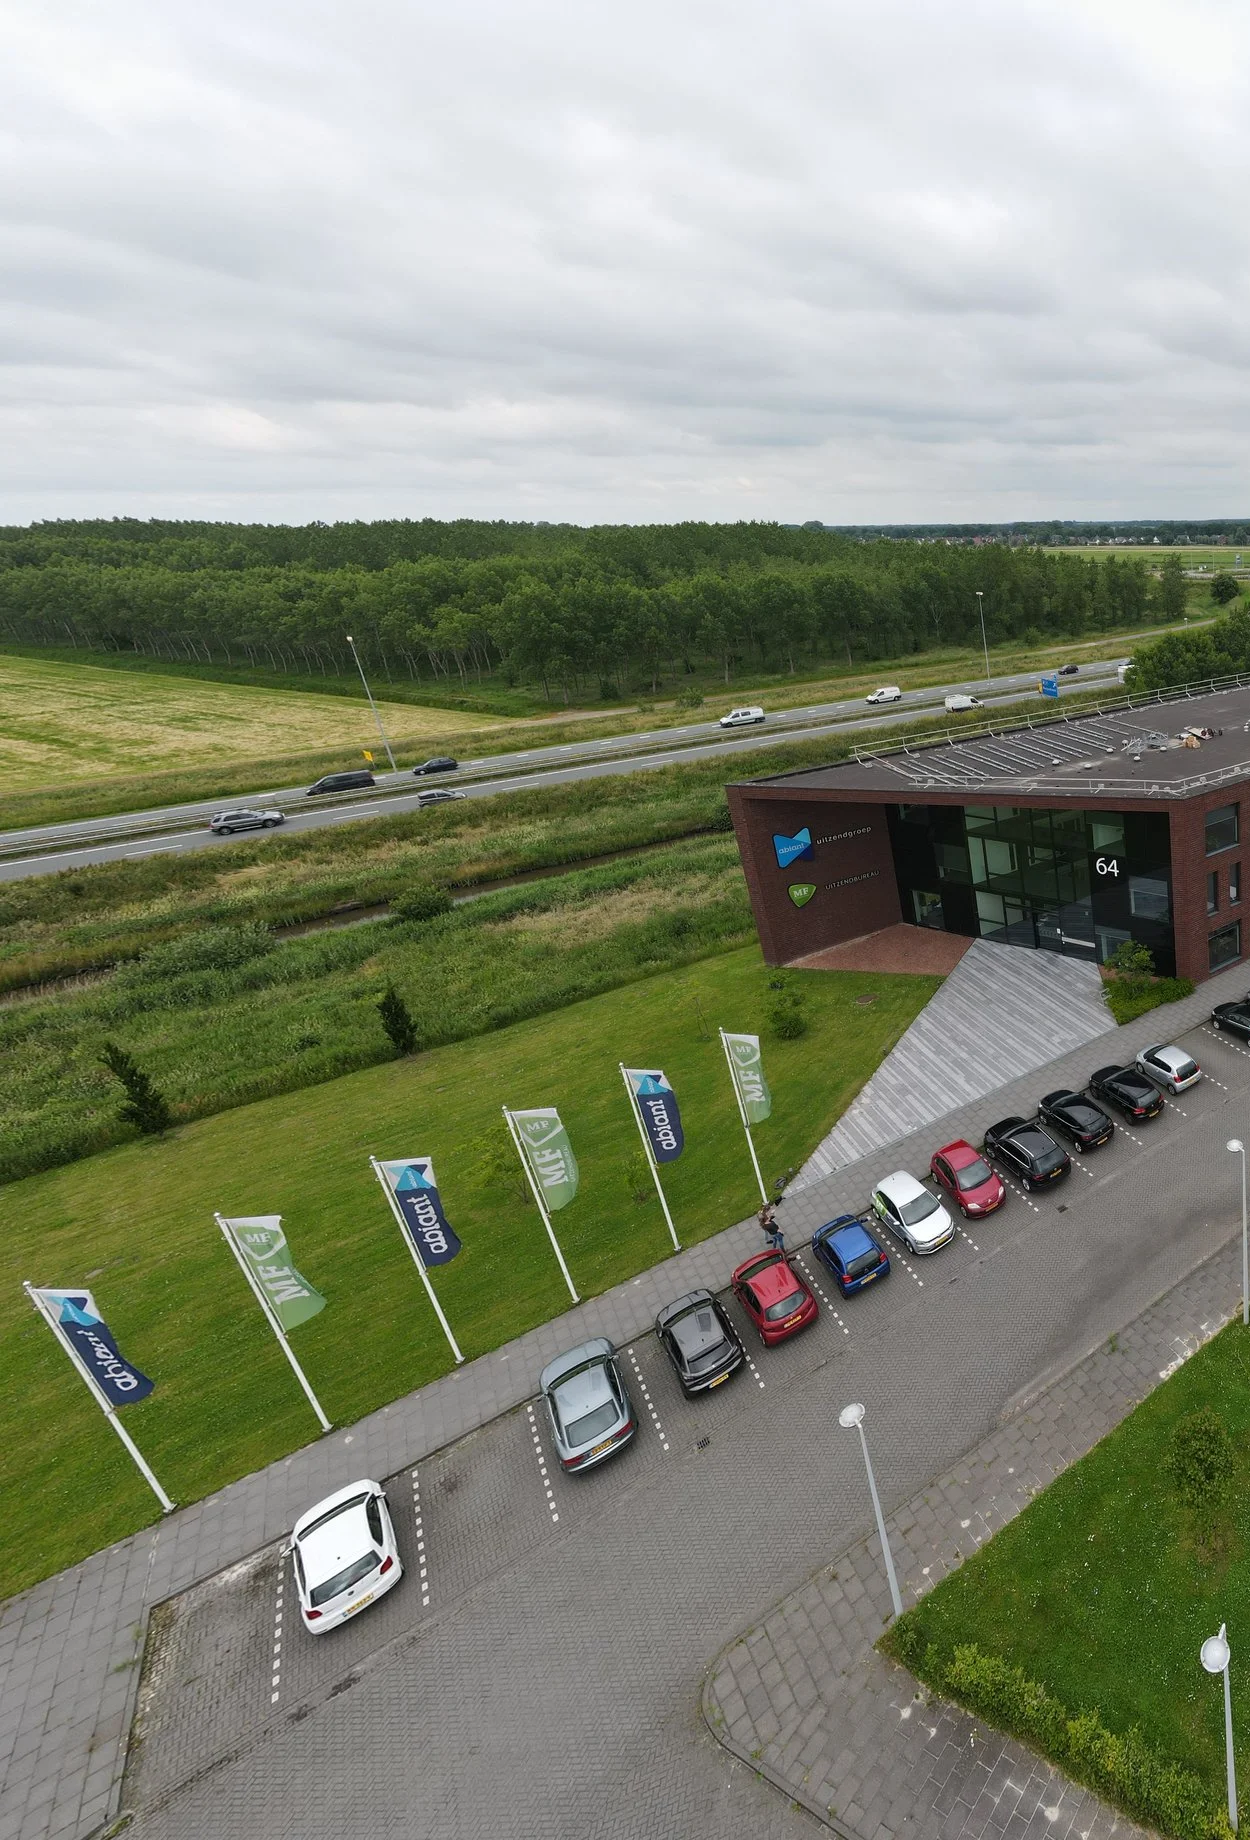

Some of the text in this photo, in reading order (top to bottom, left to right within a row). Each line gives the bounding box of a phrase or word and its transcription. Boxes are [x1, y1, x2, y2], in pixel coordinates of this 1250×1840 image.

[816, 826, 872, 845] uitzendgroep
[778, 842, 805, 855] abiant
[1096, 857, 1119, 877] 64
[793, 887, 809, 898] MF
[526, 1120, 549, 1132] MF
[646, 1100, 677, 1150] abiant
[533, 1148, 569, 1188] MF
[406, 1194, 448, 1254] abiant
[244, 1232, 271, 1243] MF
[257, 1265, 310, 1305] MF
